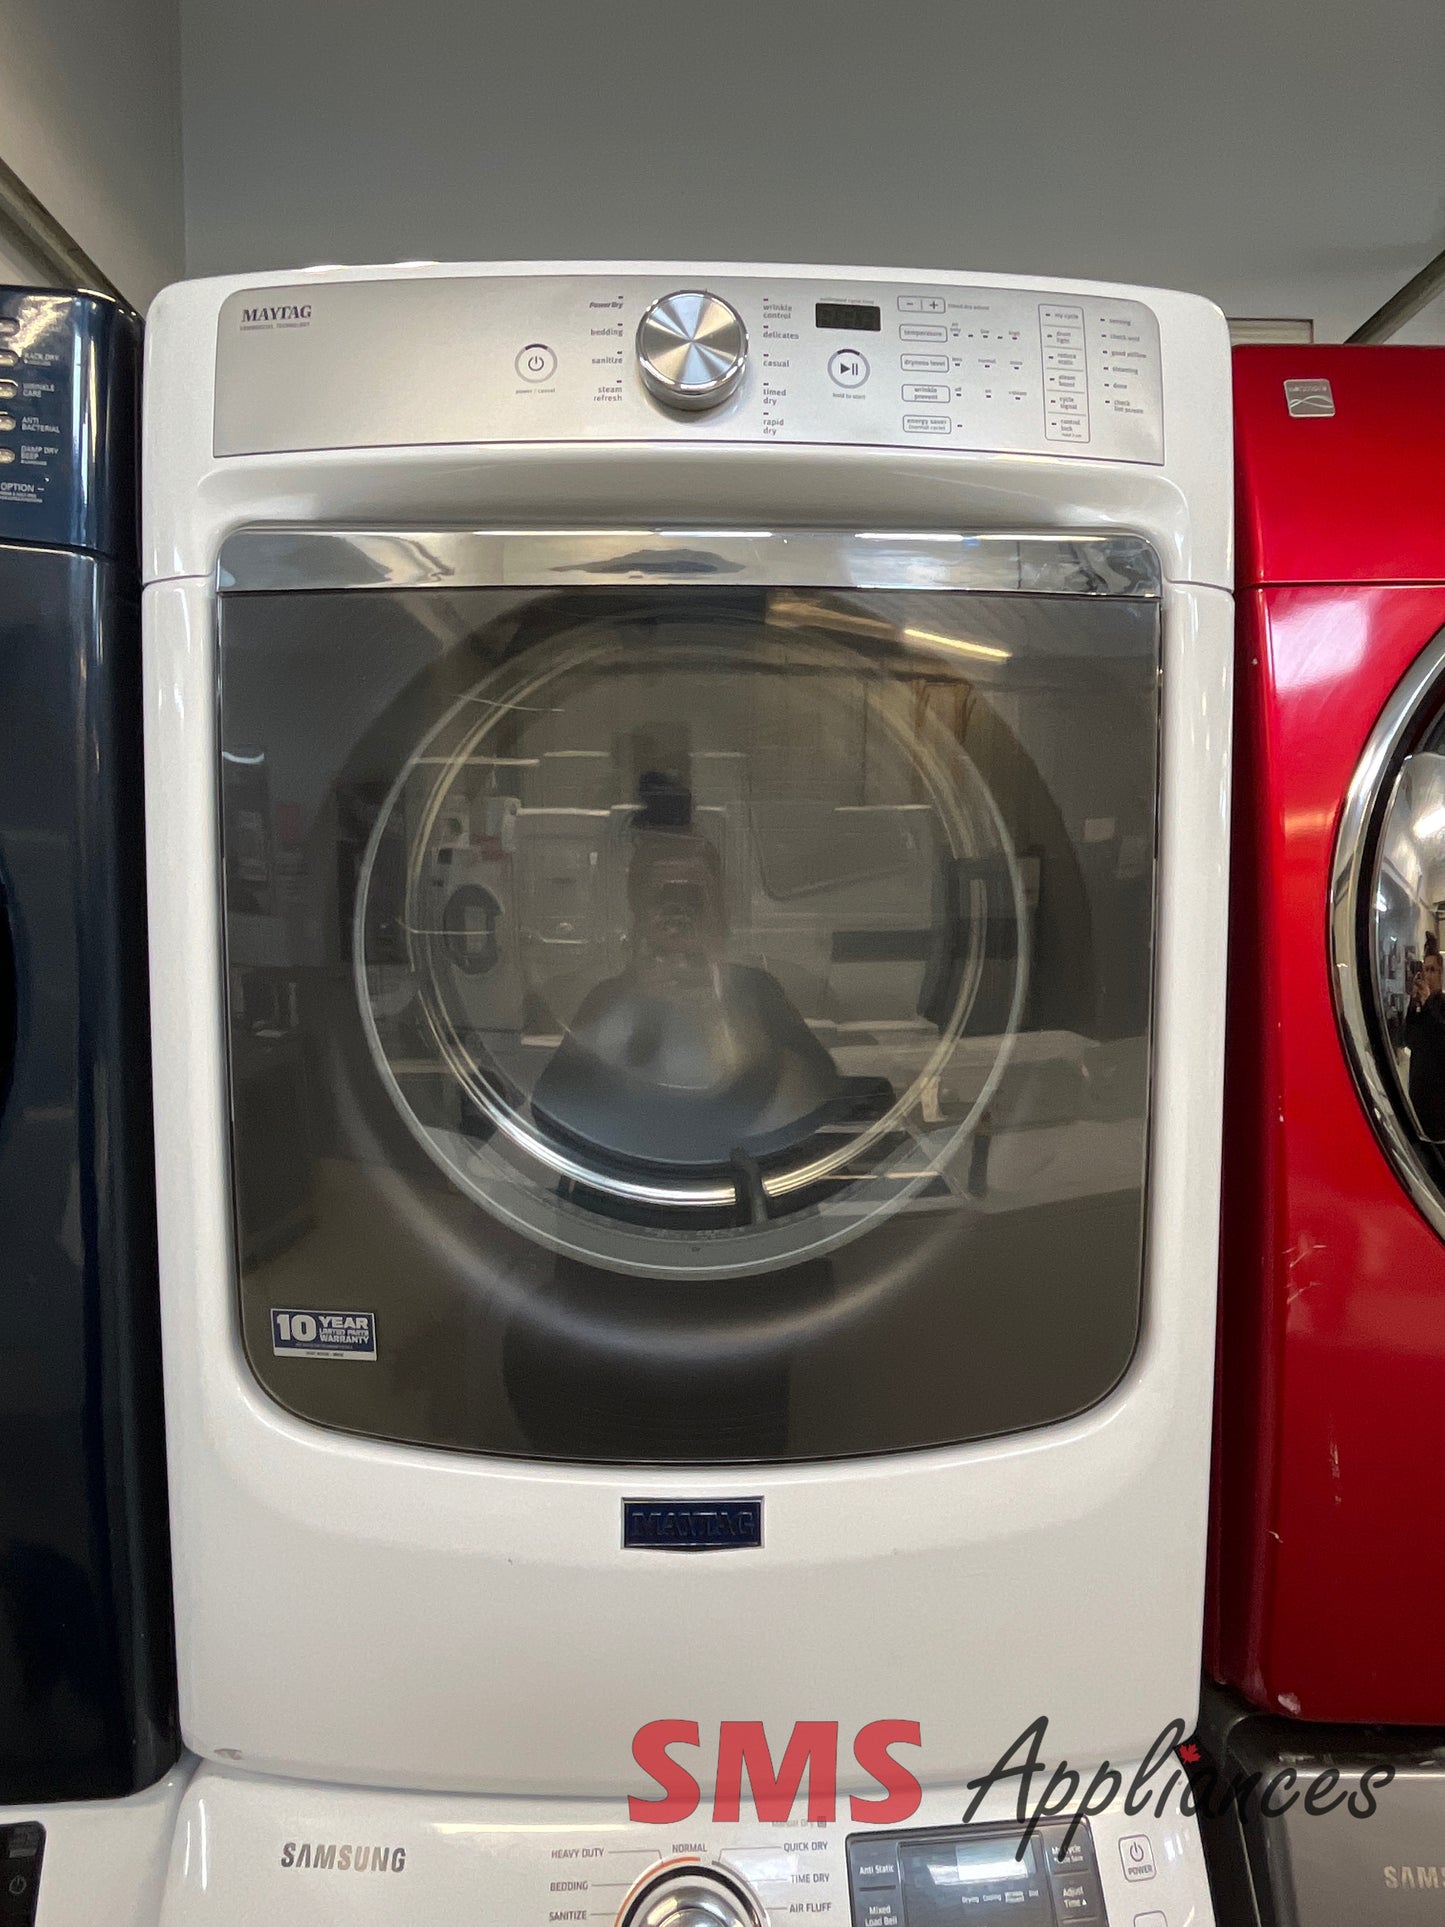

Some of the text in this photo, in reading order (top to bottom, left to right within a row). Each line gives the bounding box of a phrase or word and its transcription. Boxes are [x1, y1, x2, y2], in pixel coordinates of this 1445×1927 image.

[241, 304, 312, 322] MAYTAG
[763, 304, 792, 312] wrinkle
[763, 311, 791, 319] control
[590, 328, 623, 337] bedding
[763, 331, 799, 340] delicates
[591, 356, 623, 364] sanitize
[763, 359, 790, 367] casual
[598, 386, 623, 394] steam
[763, 388, 787, 397] timed
[593, 394, 623, 402] refresh
[763, 396, 777, 406] dry
[22, 416, 40, 424] ANTI
[763, 418, 784, 427] rapid
[21, 424, 60, 434] BACTERIAL
[763, 426, 777, 436] dry
[0, 482, 35, 493] OPTION
[276, 1313, 317, 1342] 10
[318, 1315, 369, 1330] YEAR
[320, 1334, 370, 1345] WARRANTY
[671, 1843, 708, 1854] NORMAL
[783, 1841, 828, 1853] QUICK DRY
[281, 1842, 406, 1873] SAMSUNG
[551, 1848, 605, 1859] HEAVY DUTY
[859, 1864, 894, 1875] Anti Static
[1127, 1864, 1153, 1875] POWER
[790, 1872, 830, 1884] TIME DRY
[550, 1881, 589, 1892] BEDDING
[789, 1902, 832, 1913] AIR FLUFF
[869, 1904, 891, 1915] Mixed
[549, 1910, 587, 1921] SANITIZE
[864, 1916, 882, 1927] Load
